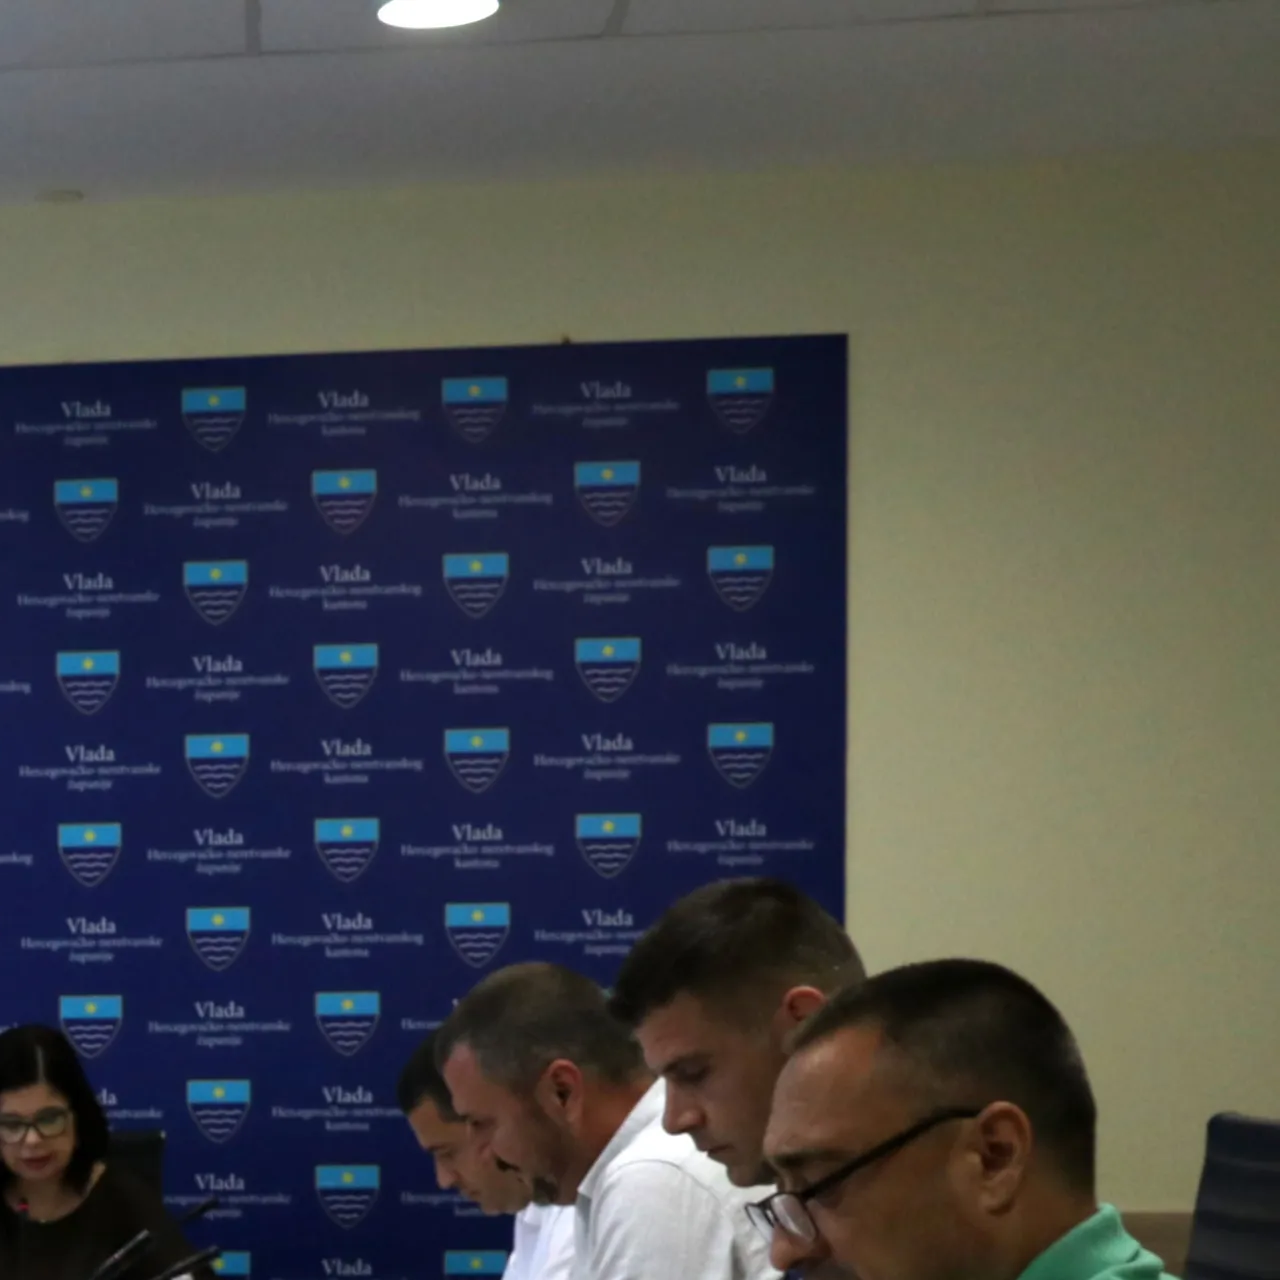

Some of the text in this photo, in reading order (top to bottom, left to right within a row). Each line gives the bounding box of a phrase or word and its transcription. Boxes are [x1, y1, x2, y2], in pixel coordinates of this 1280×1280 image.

[318, 390, 369, 408] Vlada
[581, 381, 631, 399] Vlada
[61, 400, 111, 418] Vlada
[450, 473, 501, 491] Vlada
[714, 464, 767, 483] Vlada
[191, 482, 241, 500] Vlada
[319, 564, 371, 583] Vlada
[581, 557, 633, 576] Vlada
[63, 572, 114, 590] Vlada
[450, 648, 503, 667] Vlada
[714, 642, 766, 660] Vlada
[193, 655, 243, 673] Vlada
[321, 738, 372, 757] Vlada
[581, 732, 634, 752] Vlada
[64, 744, 114, 762] Vlada
[452, 823, 503, 841] Vlada
[714, 818, 767, 837] Vlada
[193, 828, 243, 846] Vlada
[65, 916, 117, 935] Vlada
[321, 912, 373, 931] Vlada
[581, 908, 634, 927] Vlada
[194, 1000, 245, 1019] Vlada
[322, 1085, 374, 1104] Vlada
[194, 1173, 244, 1191] Vlada
[321, 1258, 372, 1276] Vlada
